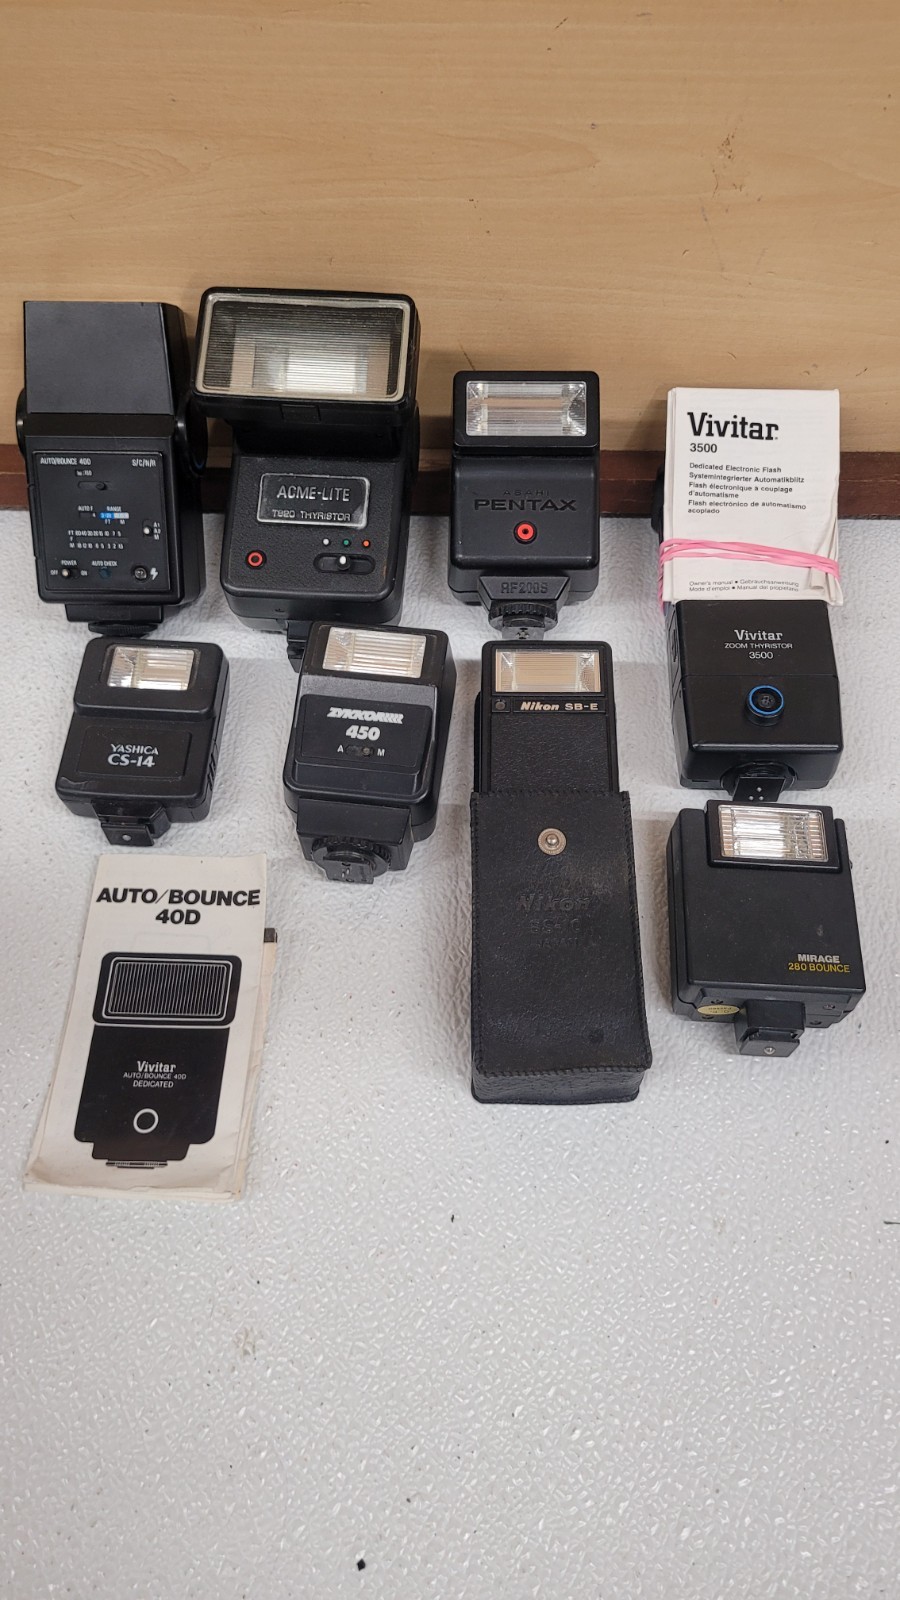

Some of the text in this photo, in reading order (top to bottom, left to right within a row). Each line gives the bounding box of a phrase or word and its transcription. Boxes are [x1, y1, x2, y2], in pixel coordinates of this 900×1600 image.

[687, 412, 779, 440] Vivitar
[690, 443, 718, 453] 3500
[40, 457, 77, 466] AUTO/BOUNCE
[690, 462, 724, 470] Dedicated
[726, 464, 760, 472] Electronic
[689, 472, 752, 482] Systemintegrierter
[710, 482, 752, 492] électronique
[276, 485, 350, 502] ACME-LITE
[688, 490, 739, 498] d'automatisme
[474, 499, 577, 512] PENTAX
[762, 502, 806, 510] automatismo
[300, 510, 350, 521] THYRISTOR
[500, 582, 548, 594] AF200S
[734, 630, 783, 640] Vivitar
[749, 651, 774, 659] 3500
[520, 702, 560, 710] Nikon
[346, 725, 380, 740] 450
[111, 744, 159, 755] YASHICA
[337, 744, 344, 753] A
[377, 748, 385, 756] M
[108, 754, 155, 768] CS-14
[96, 888, 260, 906] AUTO/BOUNCE
[156, 909, 201, 925] 40D
[798, 954, 840, 963] MIRAGE
[788, 963, 850, 973] 280 BOUNCE
[137, 1061, 176, 1072] Vivitar
